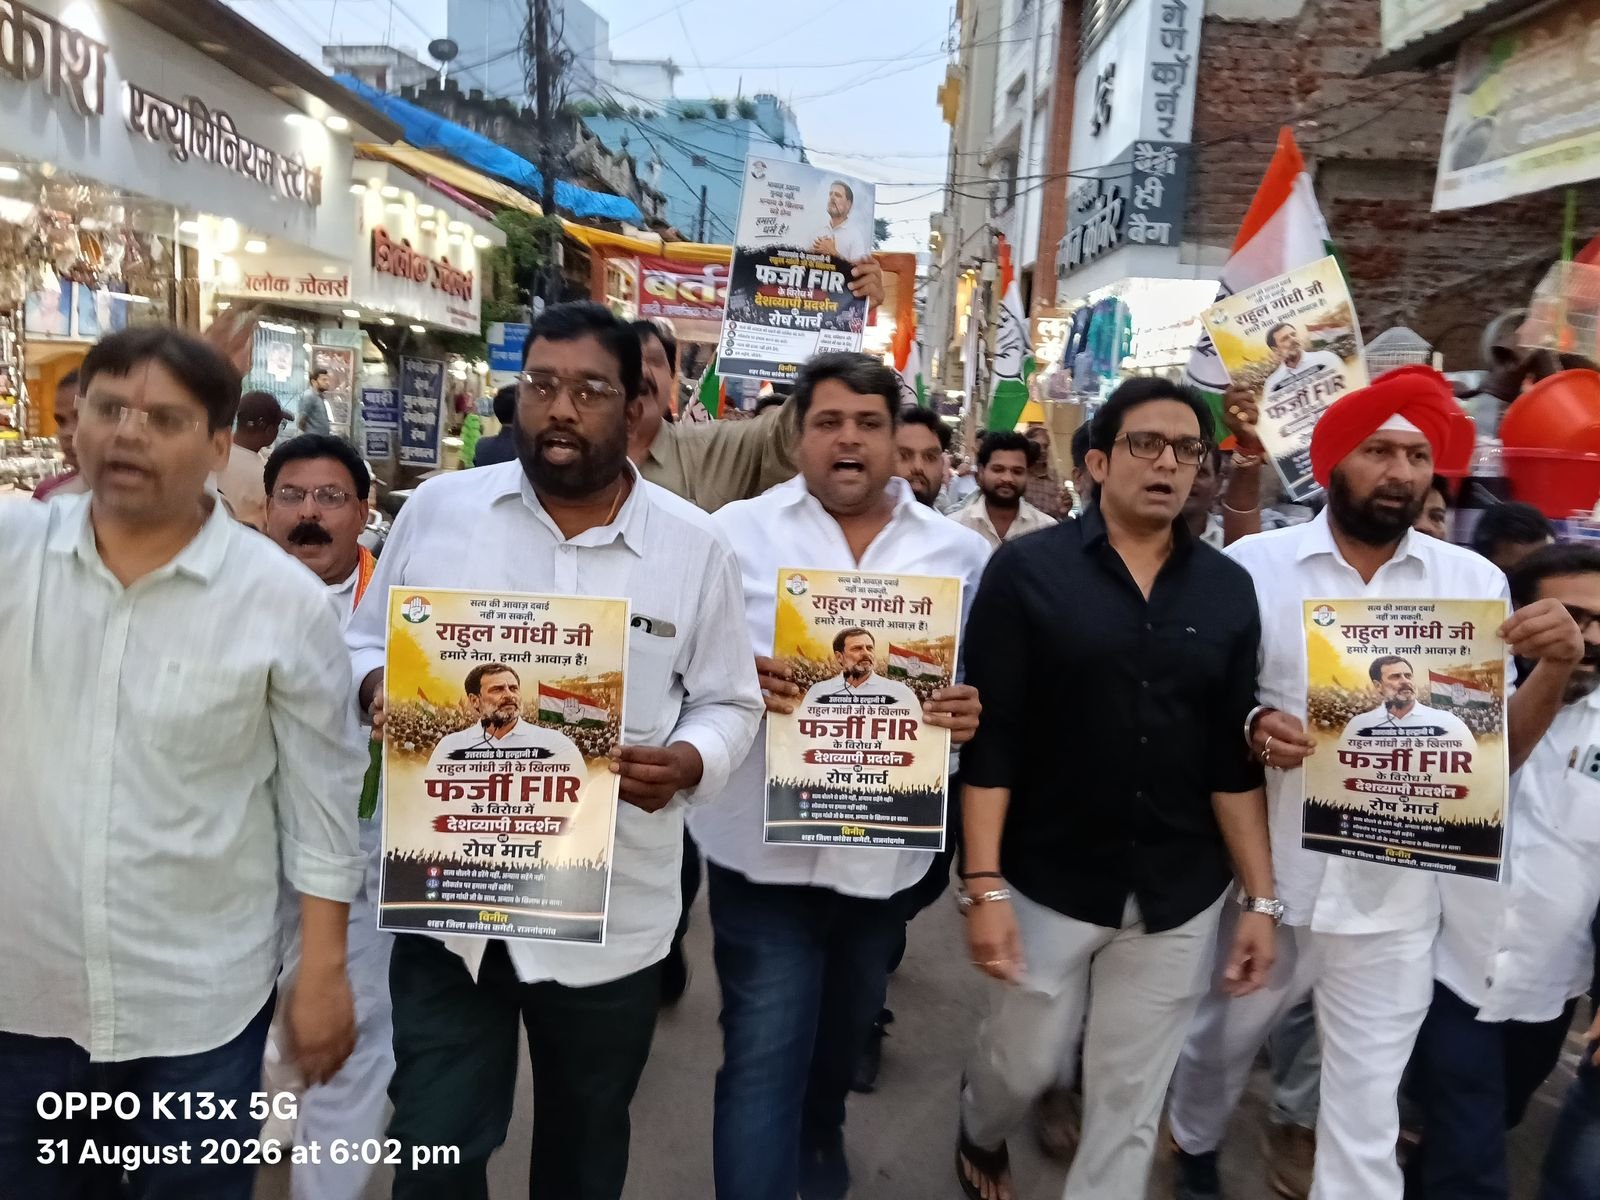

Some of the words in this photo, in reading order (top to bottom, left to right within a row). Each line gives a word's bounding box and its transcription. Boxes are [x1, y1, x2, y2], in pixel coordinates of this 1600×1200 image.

[756, 264, 806, 286] फर्जी
[807, 268, 846, 293] FIR
[1270, 288, 1304, 309] गांधी
[1305, 280, 1323, 297] जी
[769, 309, 793, 326] रोष
[795, 312, 823, 328] मार्च
[811, 594, 857, 615] राहुल
[860, 594, 905, 614] गांधी
[909, 596, 933, 615] जी
[435, 622, 495, 646] राहुल
[500, 622, 558, 645] गांधी
[562, 623, 593, 646] जी
[1341, 623, 1388, 644] राहुल
[1394, 620, 1443, 640] गांधी
[1448, 621, 1475, 640] जी
[439, 649, 467, 660] हमारे
[498, 651, 532, 664] हमारी
[534, 654, 572, 666] आवाज़
[807, 706, 830, 717] राहुल
[832, 705, 852, 716] गांधी
[854, 706, 865, 716] जी
[866, 707, 876, 716] के
[878, 707, 910, 717] खिलाफ
[797, 715, 866, 742] फर्जी
[870, 717, 918, 742] FIR
[832, 739, 842, 748] के
[844, 739, 872, 750] विरोध
[873, 740, 882, 750] में
[813, 750, 864, 765] देशव्यापी
[865, 751, 903, 764] प्रदर्शन
[1336, 747, 1413, 775] फर्जी
[1419, 750, 1472, 775] FIR
[436, 764, 467, 776] राहुल
[469, 762, 497, 772] गांधी
[499, 762, 514, 772] जी
[516, 762, 527, 772] के
[529, 762, 570, 773] खिलाफ
[827, 769, 852, 784] रोष
[856, 770, 888, 785] मार्च
[1376, 772, 1386, 780] के
[1390, 773, 1420, 782] विरोध
[1422, 773, 1432, 783] में
[424, 773, 514, 804] फर्जी
[520, 775, 580, 804] FIR
[1356, 781, 1410, 796] देशव्यापी
[1414, 784, 1456, 798] प्रदर्शन
[471, 802, 484, 814] के
[486, 802, 522, 816] विरोध
[524, 802, 535, 816] में
[1369, 798, 1396, 811] रोष
[1402, 801, 1439, 816] मार्च
[446, 815, 511, 833] देशव्यापी
[513, 816, 563, 833] प्रदर्शन
[463, 839, 496, 858] रोष
[500, 840, 542, 858] मार्च
